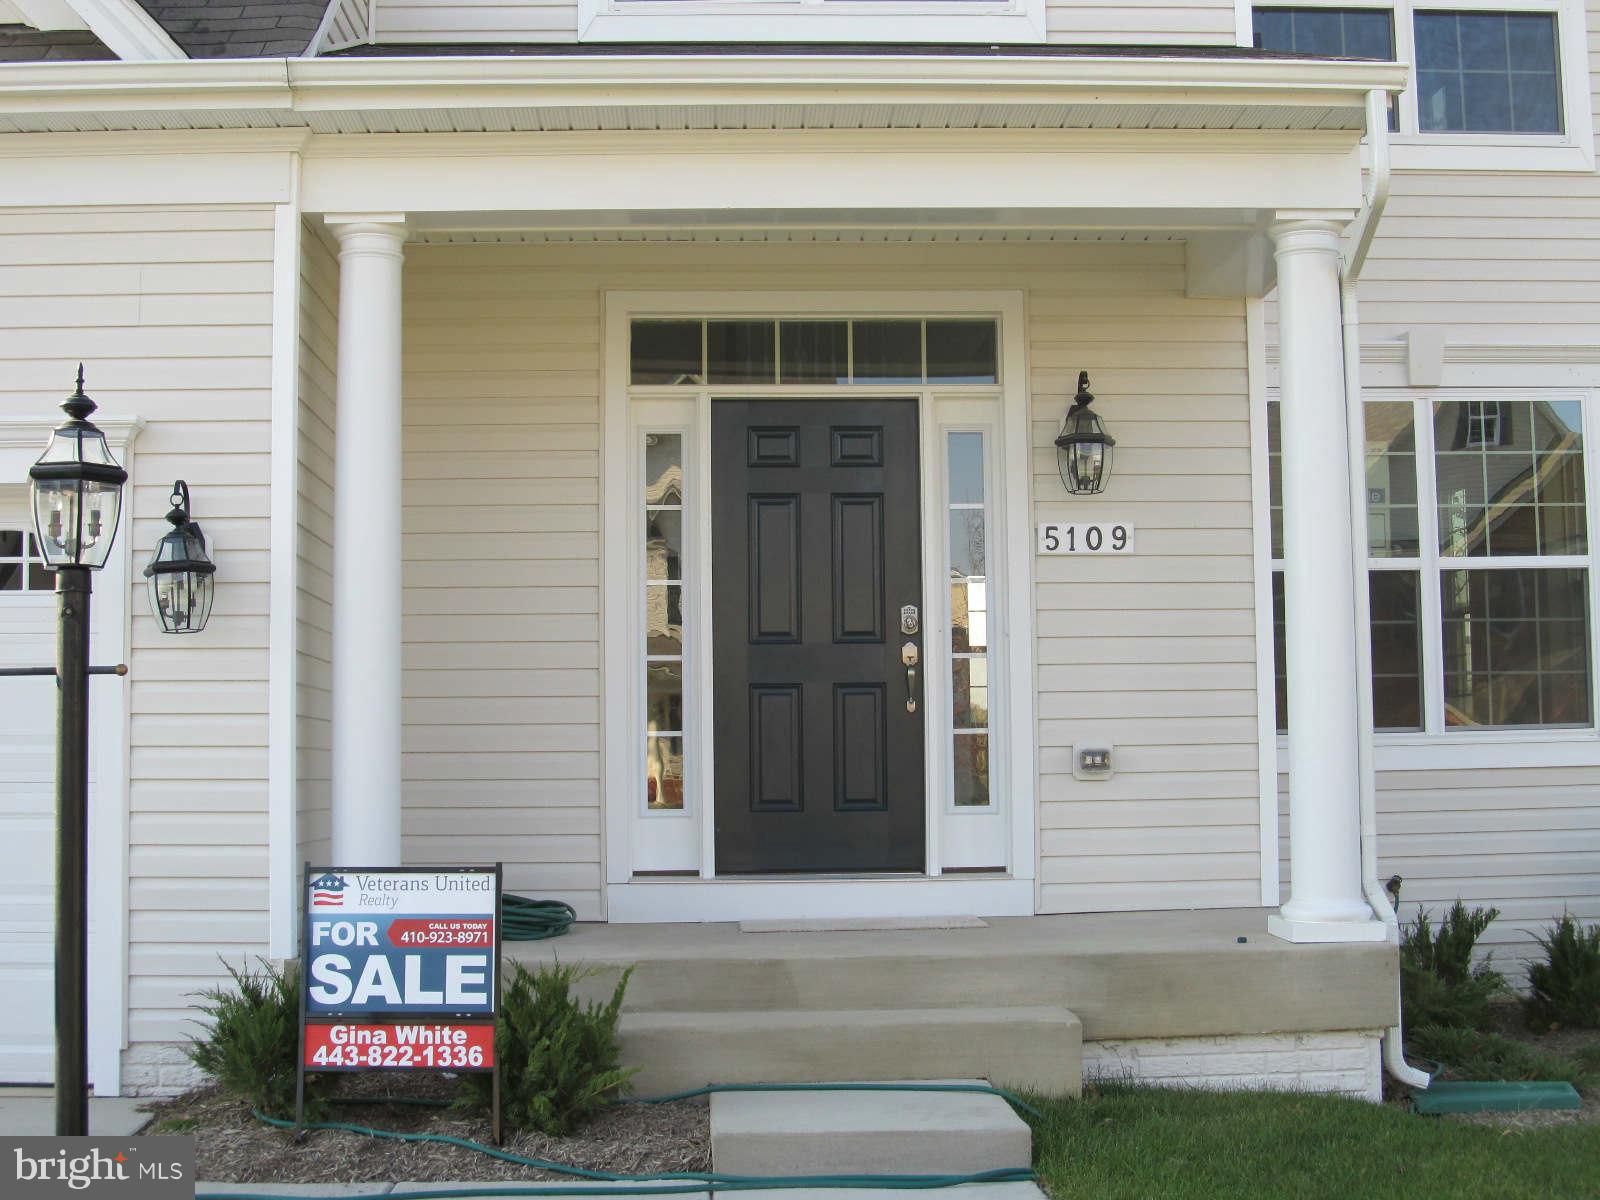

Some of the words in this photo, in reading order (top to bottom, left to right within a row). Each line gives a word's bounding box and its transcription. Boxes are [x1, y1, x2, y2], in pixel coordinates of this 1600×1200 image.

[1045, 525, 1127, 551] 5109
[356, 875, 429, 891] Veterans
[435, 875, 490, 891] United
[358, 893, 399, 909] Realty
[312, 921, 379, 946] FOR
[401, 931, 488, 944] 410-923-8971
[309, 953, 487, 1005] SALE
[330, 1025, 387, 1044] Gina
[395, 1025, 468, 1044] White
[312, 1045, 483, 1067] 443-822-1336
